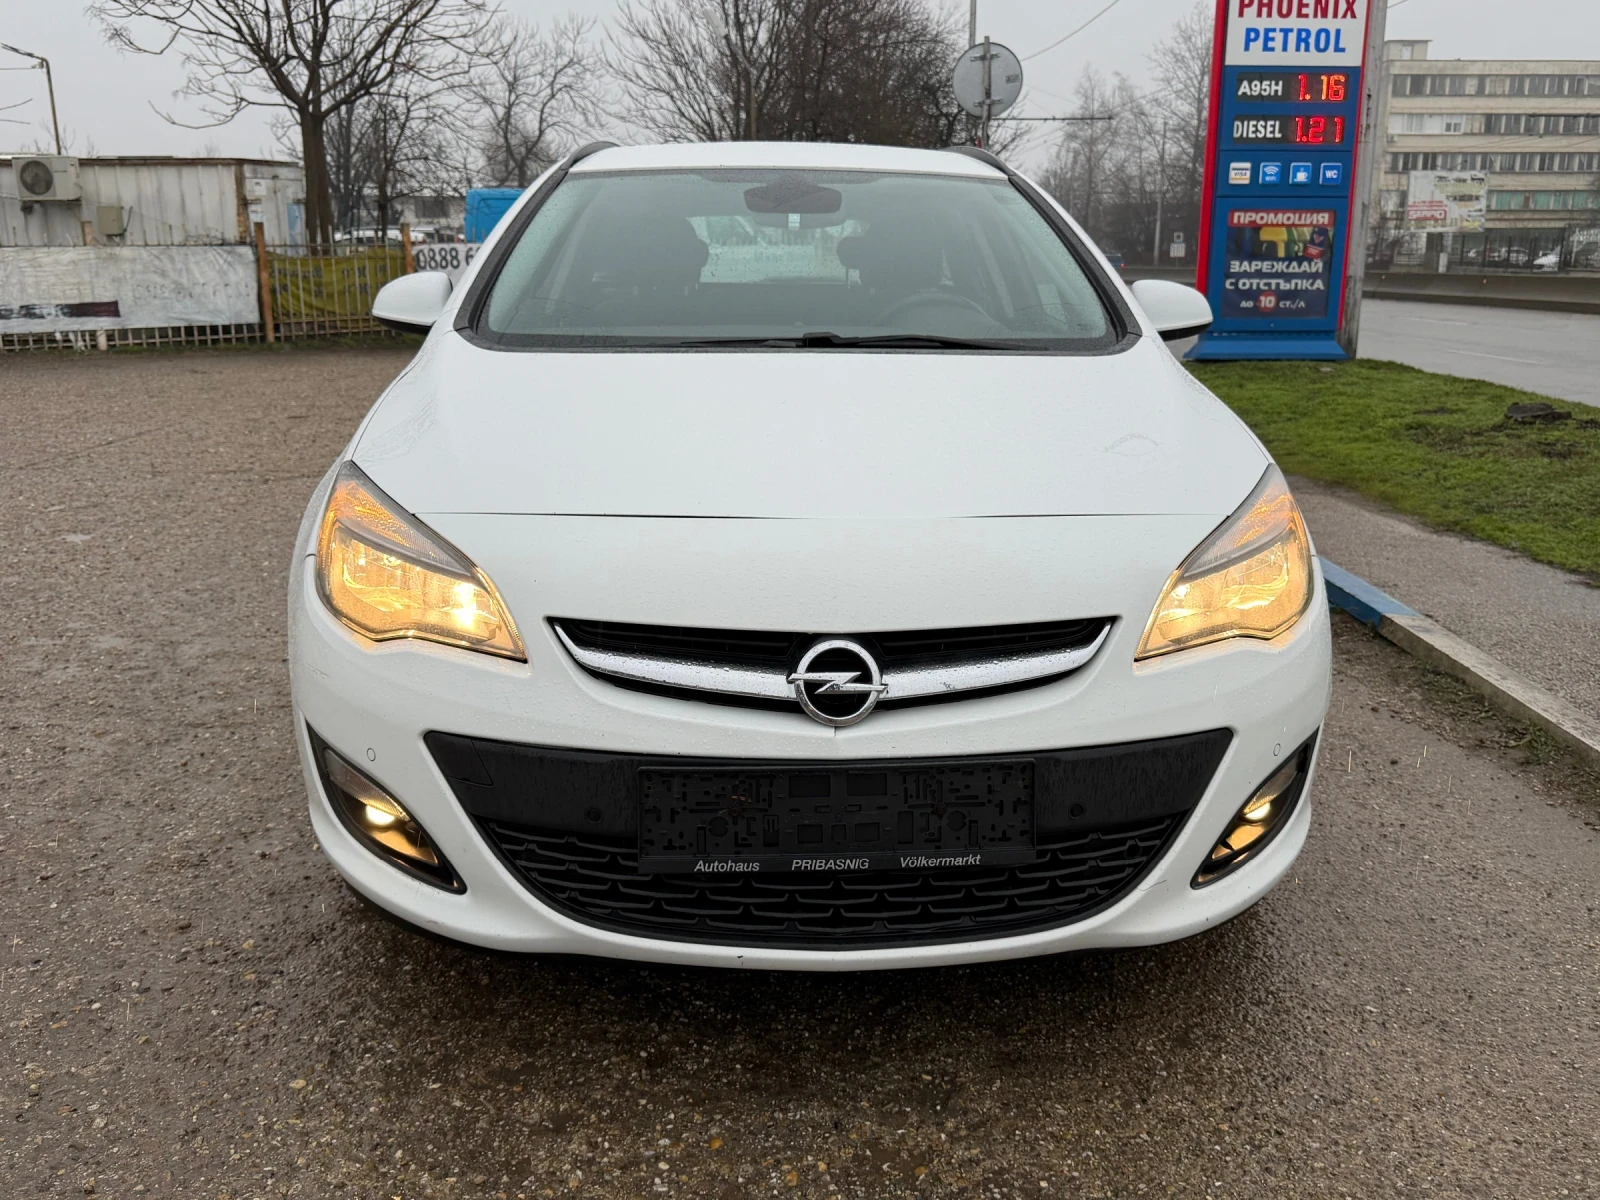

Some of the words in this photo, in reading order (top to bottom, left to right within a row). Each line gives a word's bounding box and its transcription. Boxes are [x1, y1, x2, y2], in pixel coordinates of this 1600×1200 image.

[1237, 0, 1357, 19] PHOENIX
[1243, 28, 1346, 53] PETROL
[1237, 80, 1283, 96] A95H
[1298, 74, 1345, 101] 1.16
[1233, 120, 1282, 138] DIESEL
[1295, 117, 1343, 143] 1.21
[1325, 170, 1338, 178] WC
[1233, 212, 1329, 225] ПРОМОЦИЯ
[416, 247, 460, 270] 0888
[1230, 259, 1323, 273] ЗАРЕЖДАЙ
[1225, 279, 1236, 289] С
[1238, 278, 1324, 290] ОТСТЪПКА
[1259, 296, 1275, 308] 10
[694, 860, 760, 872] Autohaus
[791, 858, 870, 871] PRIBASNIG
[900, 854, 981, 868] Völkermarkt
